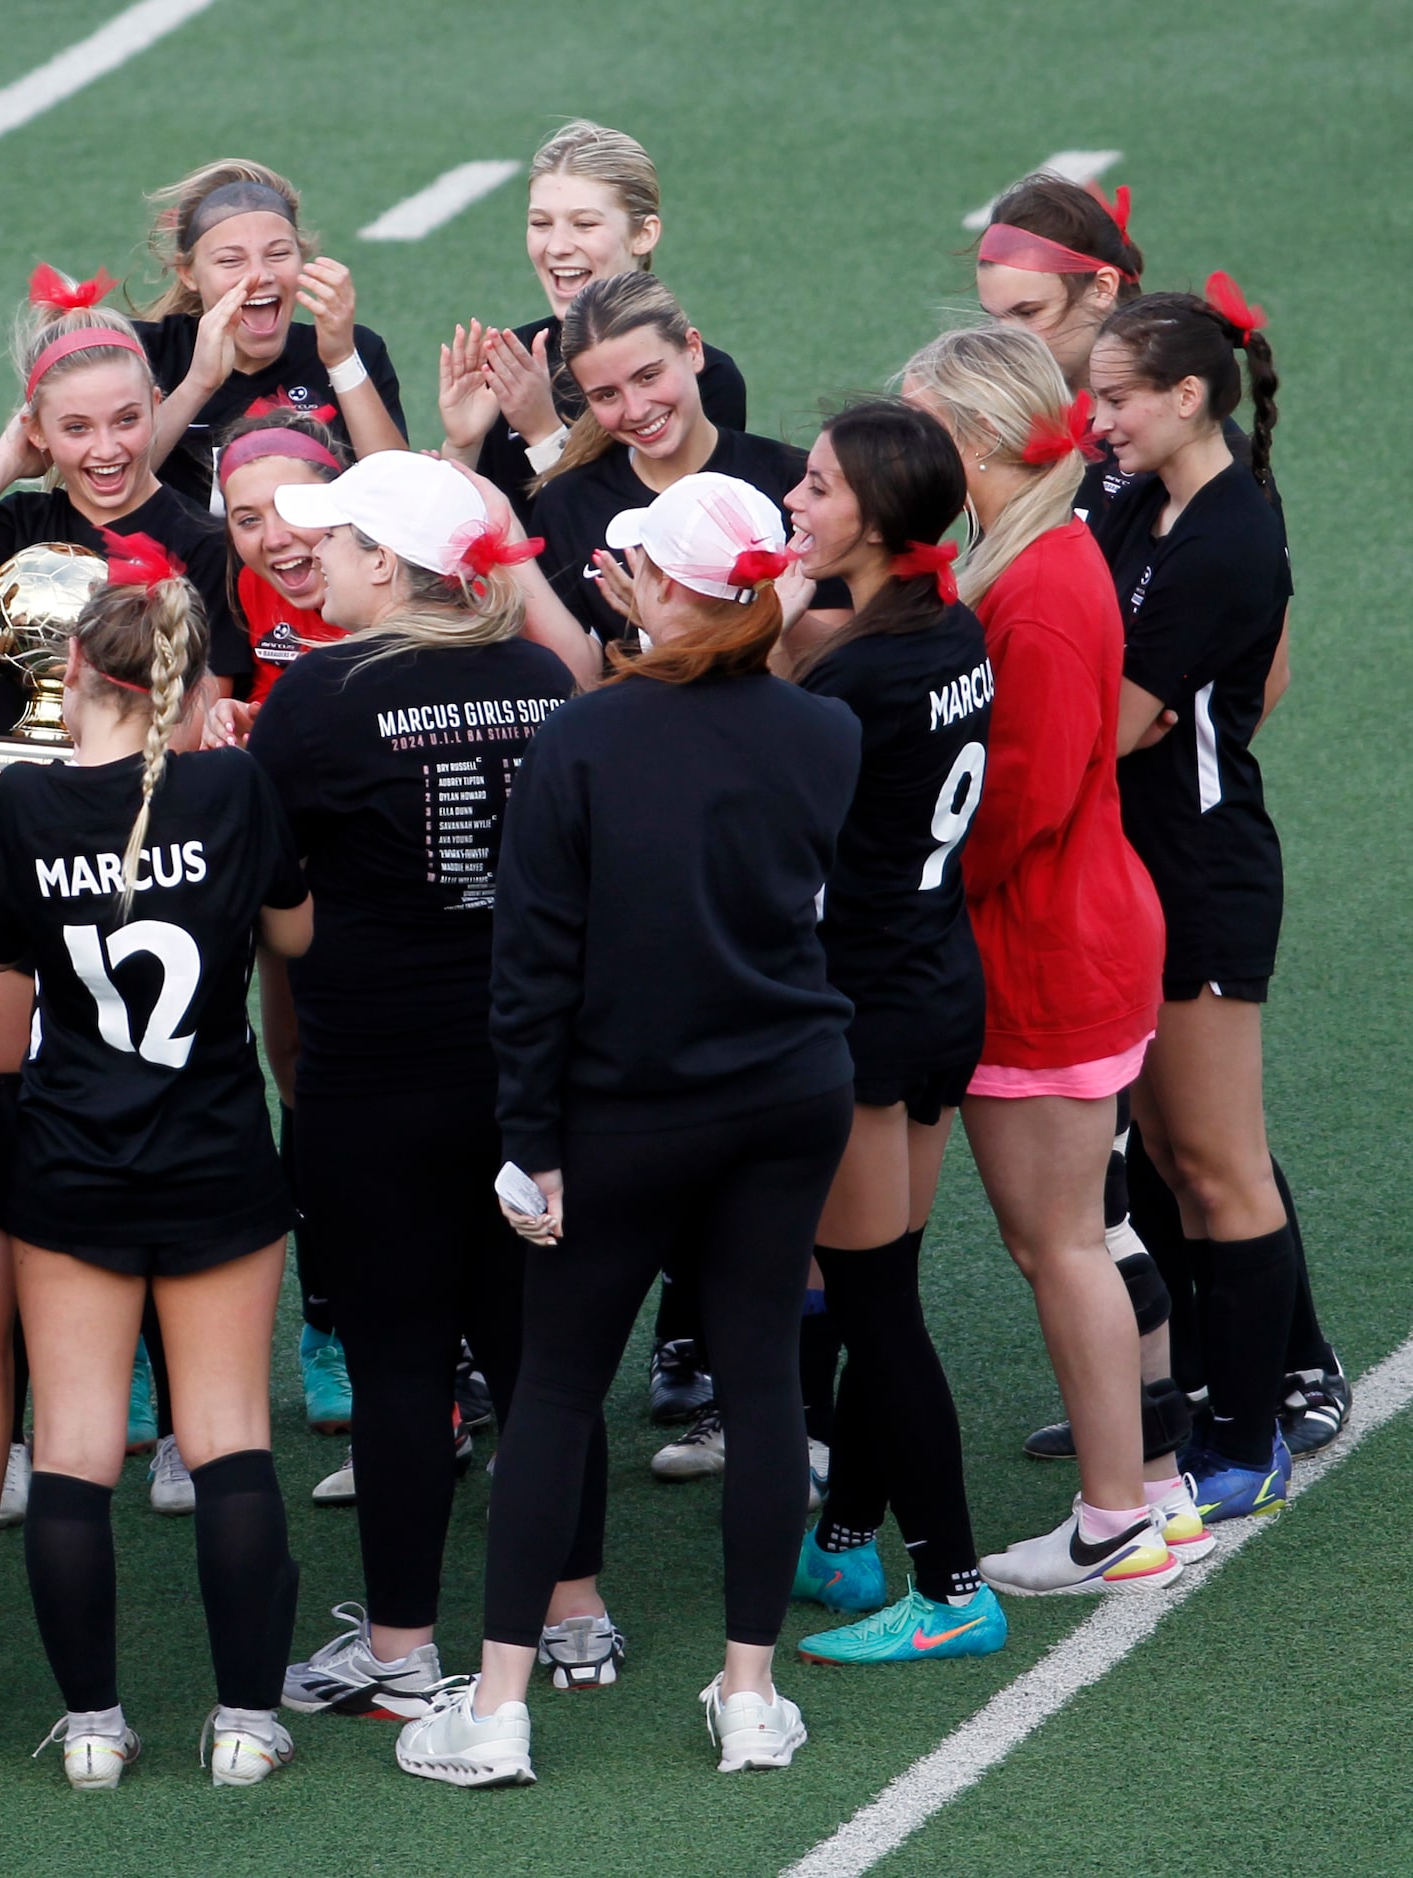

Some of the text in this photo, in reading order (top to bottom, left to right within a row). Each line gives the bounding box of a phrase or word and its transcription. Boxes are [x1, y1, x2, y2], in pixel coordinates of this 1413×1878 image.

[377, 703, 460, 738] MARCUS
[464, 700, 515, 727] GIRLS
[391, 734, 425, 751] 2024
[488, 721, 520, 741] STATE
[463, 775, 485, 785] TIPTON
[438, 792, 459, 802] DYLAN
[460, 790, 487, 800] HOWARD
[439, 807, 454, 816] ELLA
[918, 741, 986, 890] 9
[439, 820, 472, 830] SAVANNAH
[438, 835, 451, 844] AVA
[35, 840, 207, 897] MARCUS
[465, 862, 483, 872] HAYES
[63, 920, 201, 1068] 12
